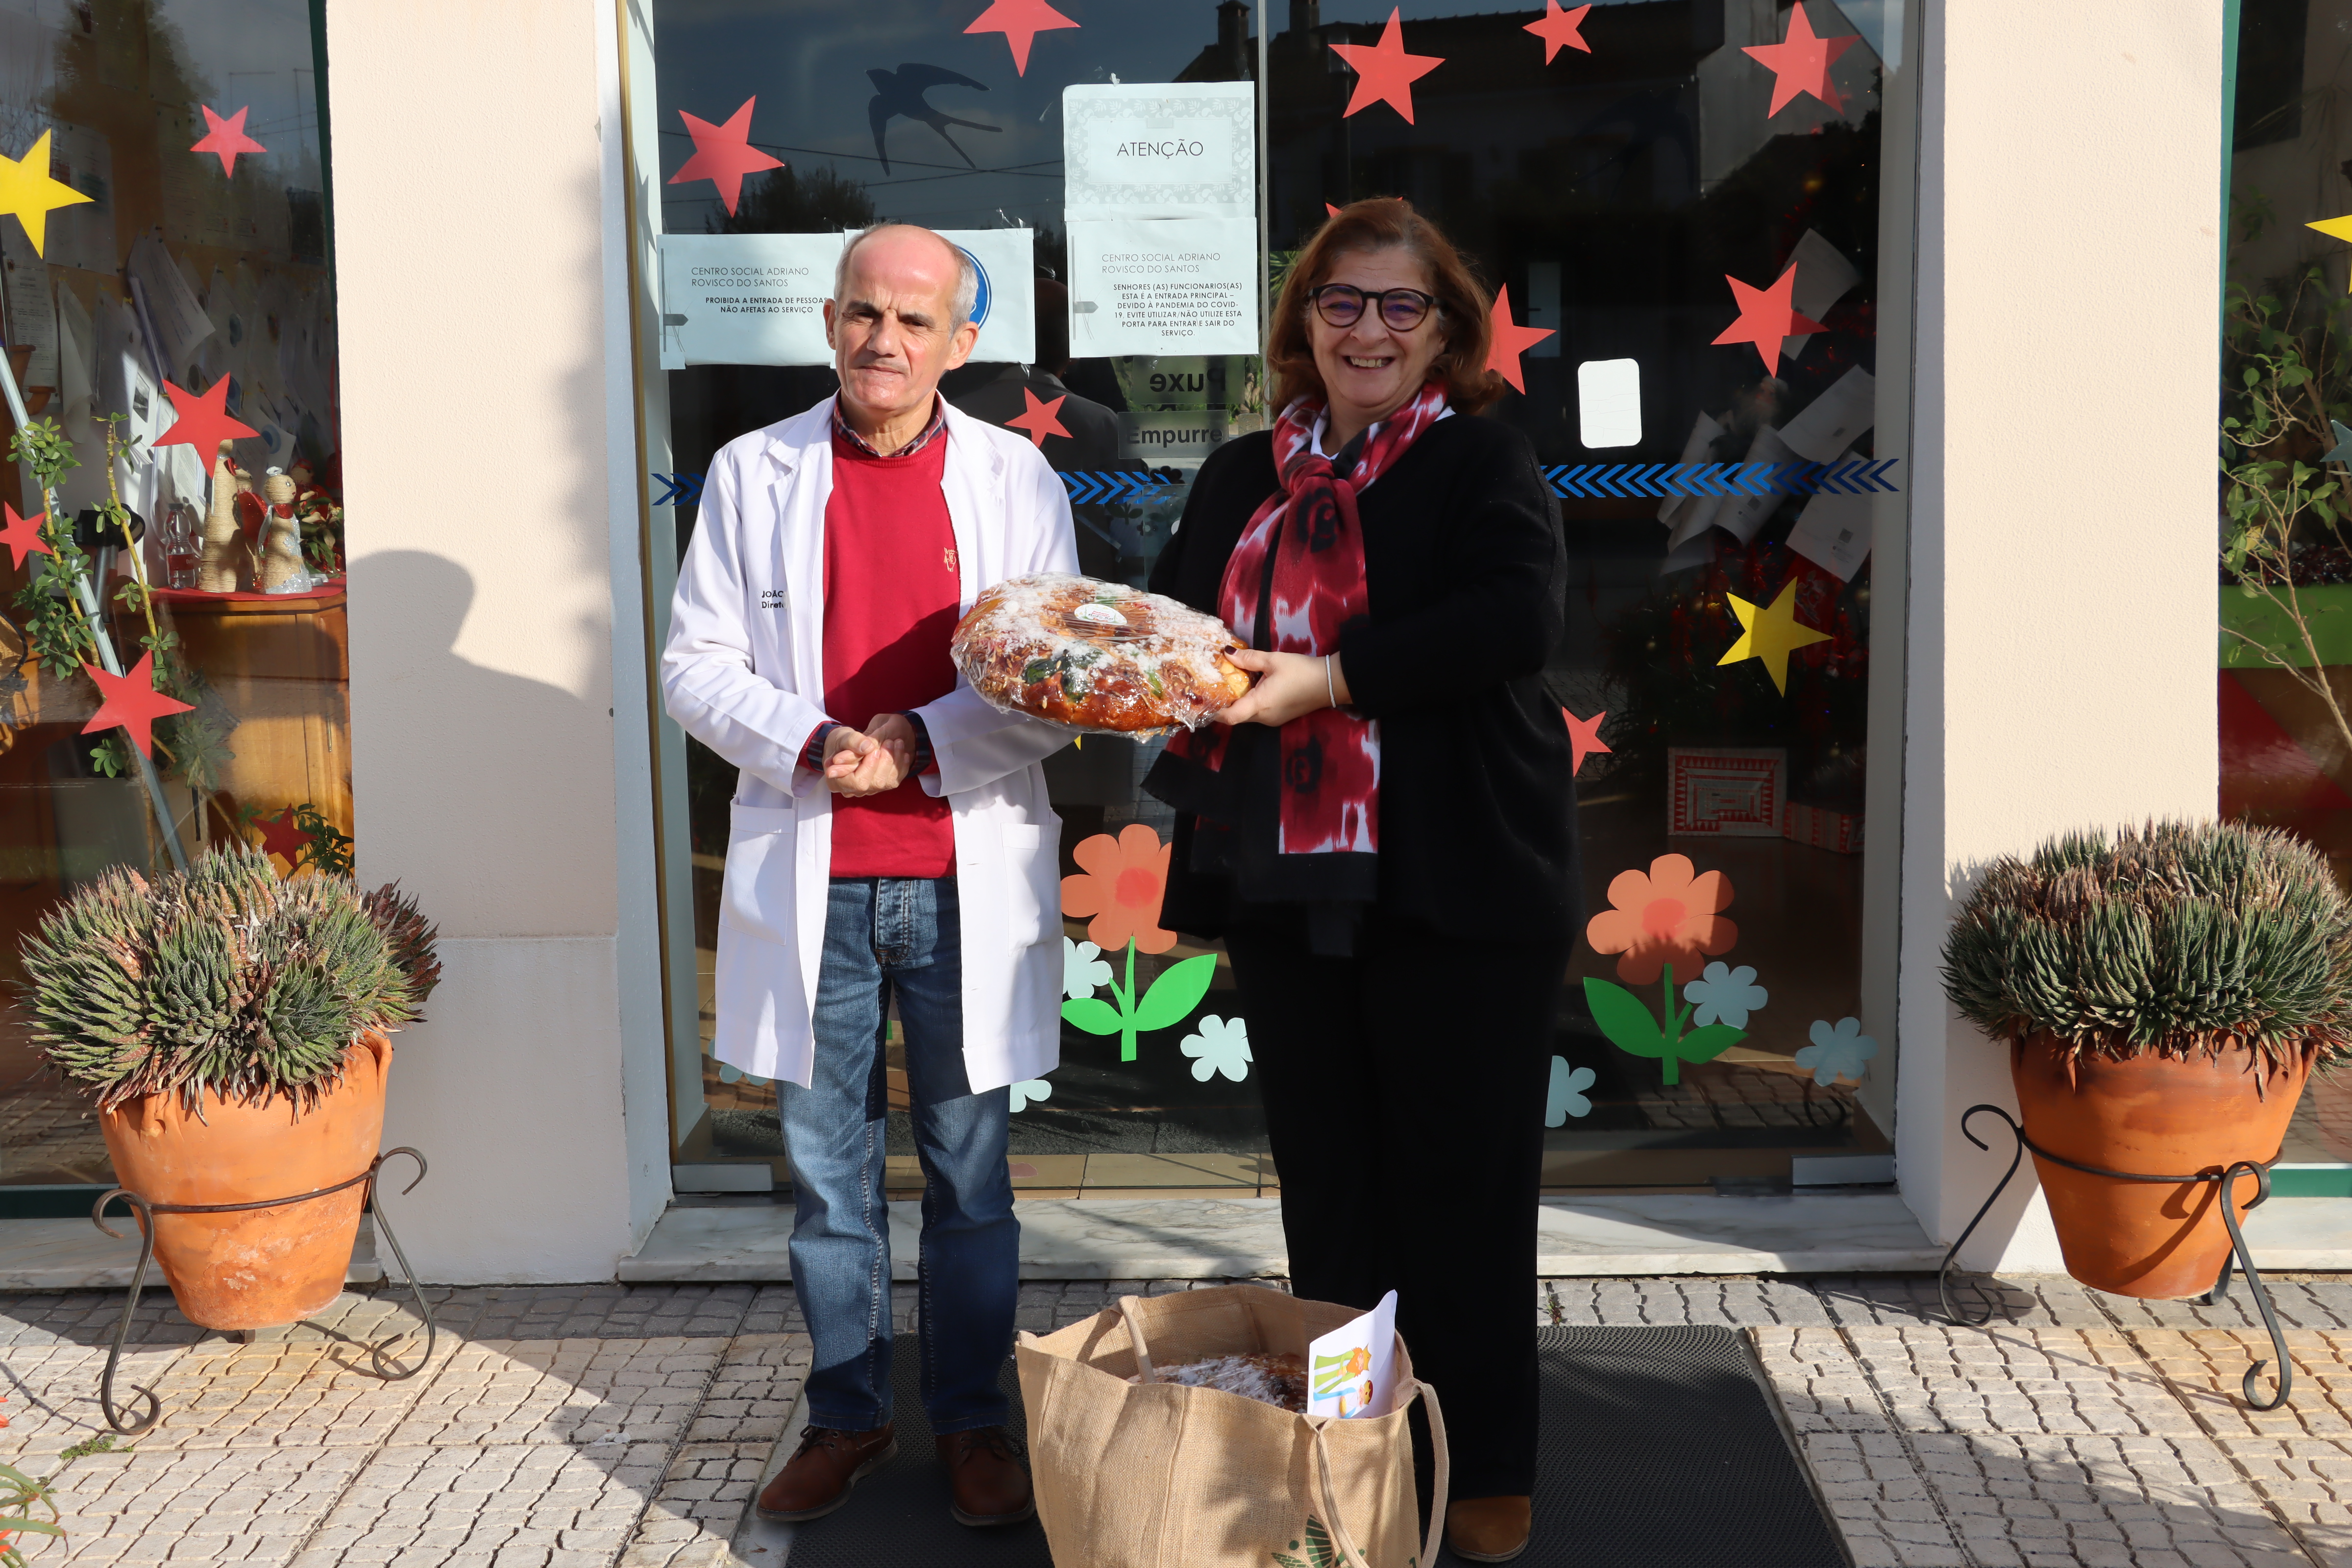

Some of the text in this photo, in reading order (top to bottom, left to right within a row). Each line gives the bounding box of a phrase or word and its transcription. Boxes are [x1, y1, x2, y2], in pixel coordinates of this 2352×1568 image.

[1117, 139, 1203, 160] ATENÇÃO
[1102, 252, 1221, 262] CENTRO SOCIAL ADRIANO
[691, 267, 809, 276] CENTRO SOCIAL ADRIANO
[1102, 265, 1200, 274] ROVISCO DO SANTOS
[691, 278, 788, 287] ROVISCO DO SANTOS
[1152, 283, 1168, 292] (AS)
[1141, 291, 1144, 299] É
[720, 305, 738, 313] NÃO
[1148, 300, 1153, 309] À
[1148, 310, 1198, 318] UTILIZAR/NÃO
[1128, 426, 1223, 448] Empurre
